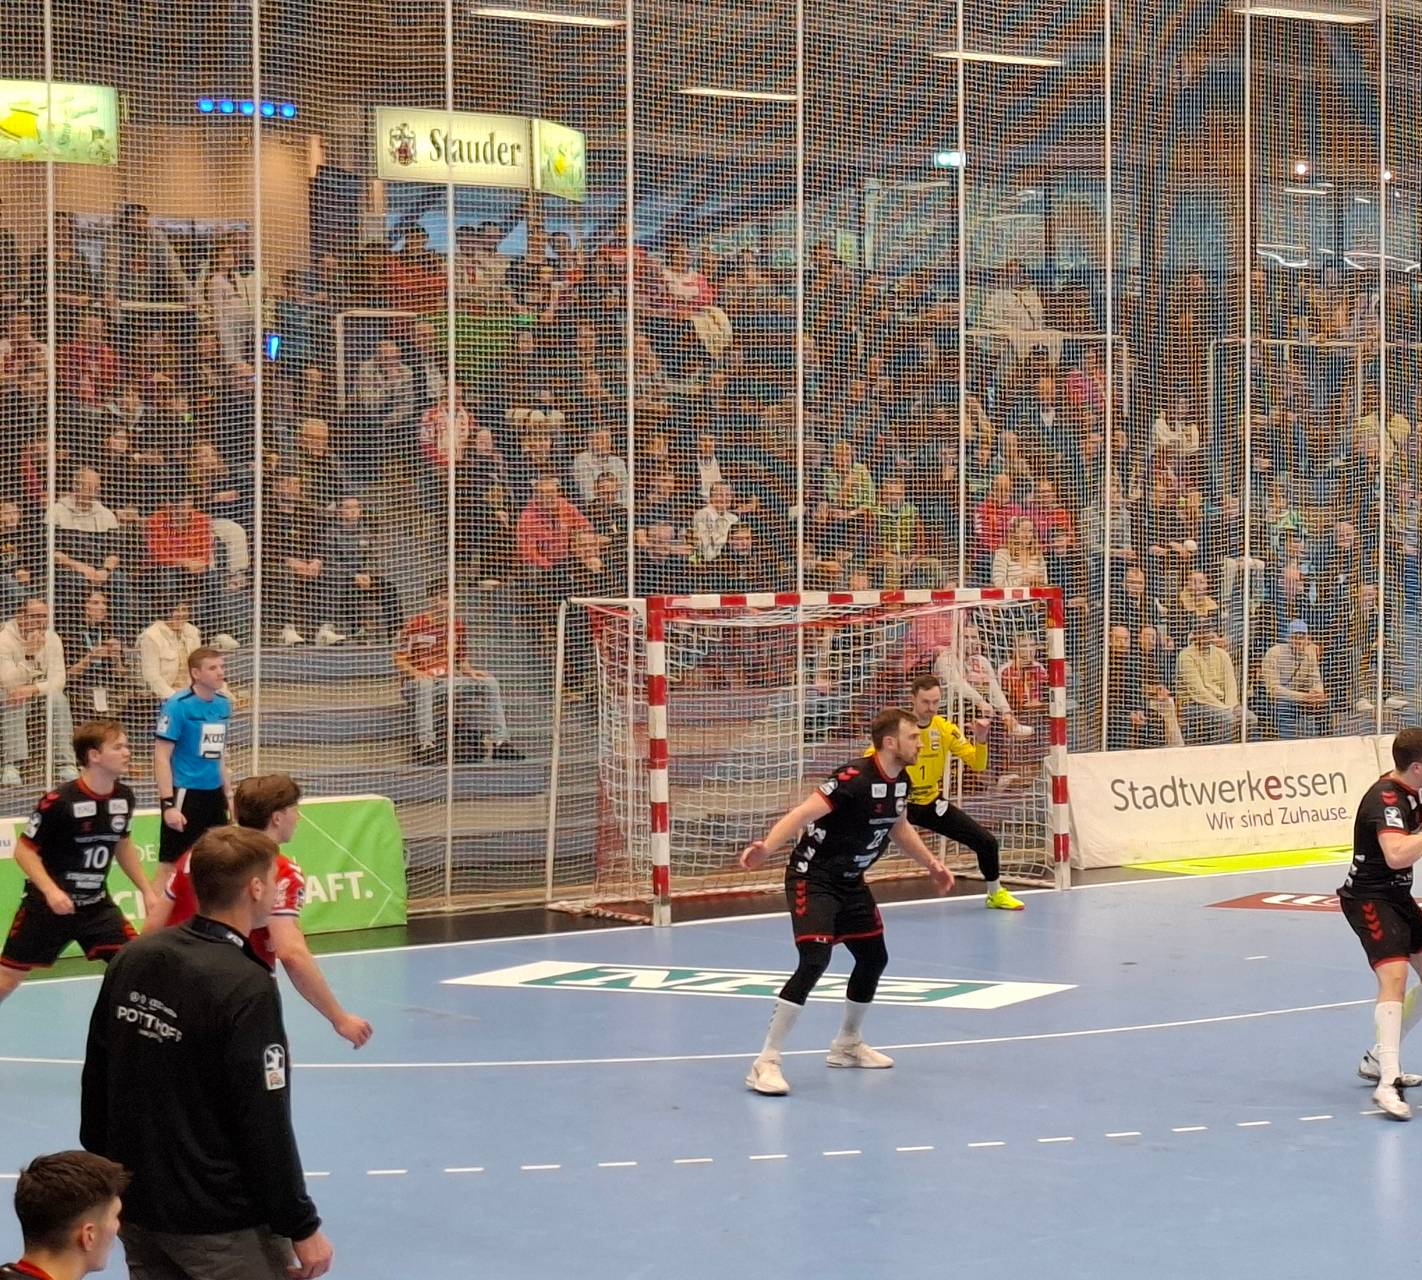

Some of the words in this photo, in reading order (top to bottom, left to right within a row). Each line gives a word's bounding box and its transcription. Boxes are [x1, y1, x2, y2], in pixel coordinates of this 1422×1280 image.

[429, 127, 523, 167] Stauder
[919, 764, 926, 781] 1
[1110, 770, 1348, 812] Stadtwerkessen
[1206, 811, 1235, 831] Wir
[1240, 809, 1274, 828] sind
[1281, 804, 1353, 825] Zuhause.
[84, 845, 109, 869] 10
